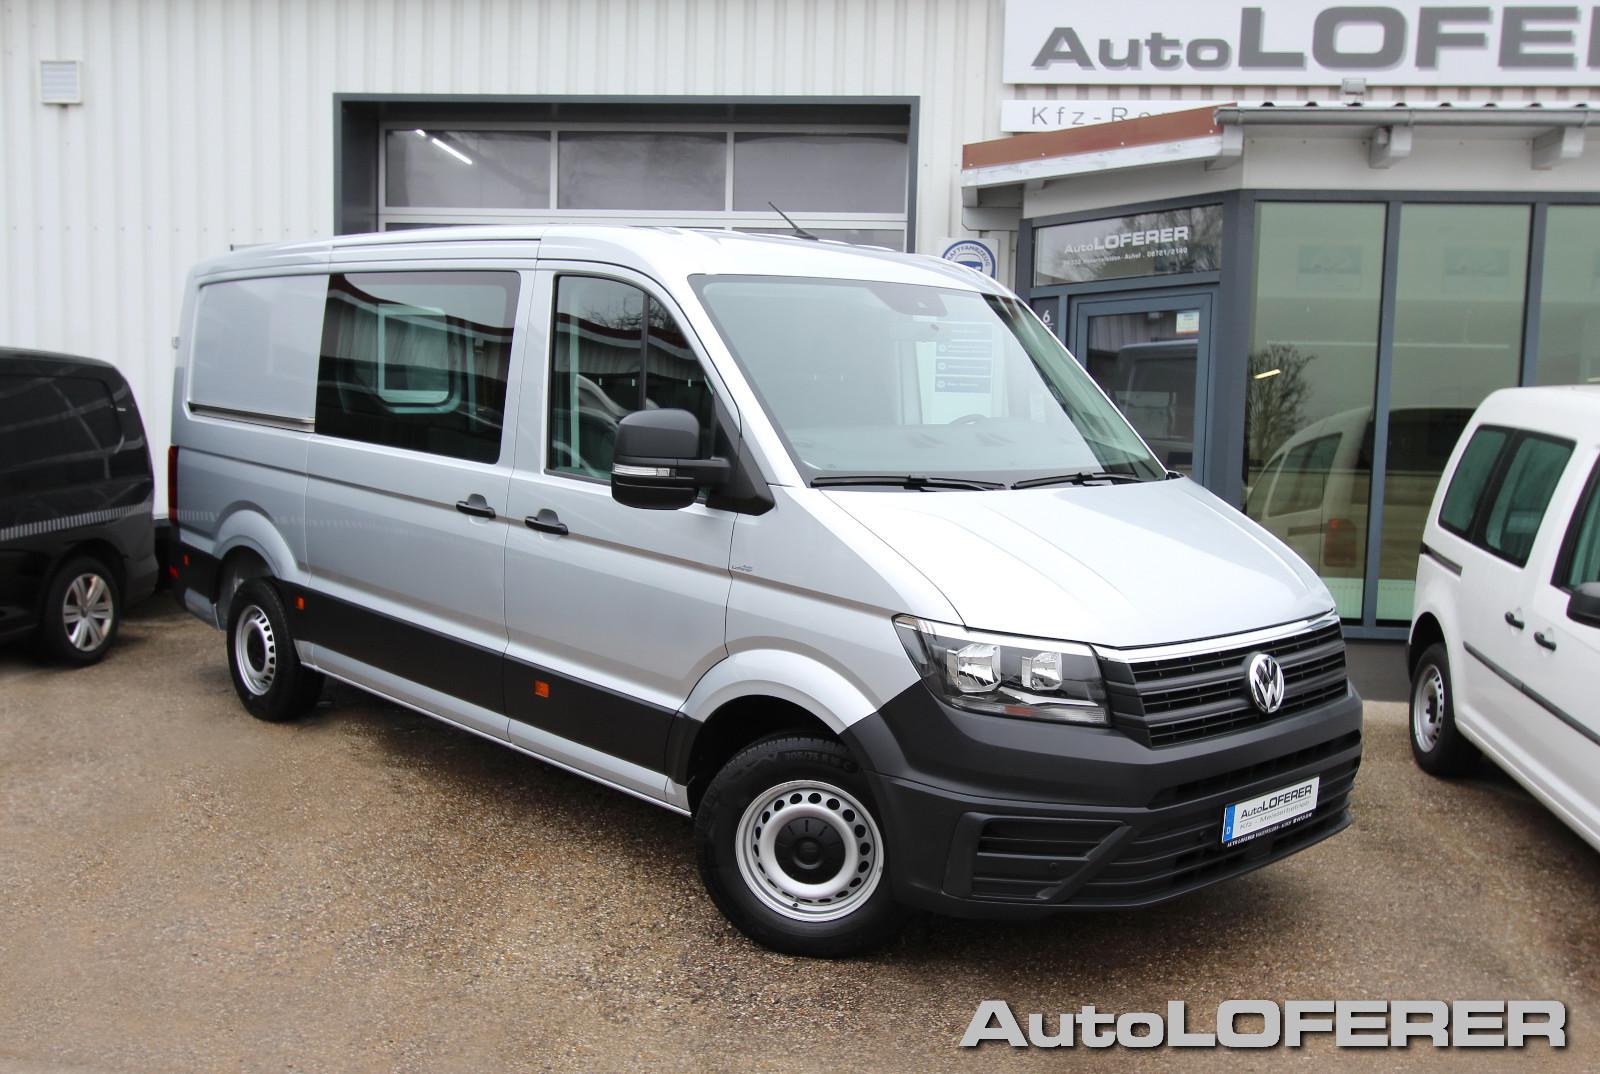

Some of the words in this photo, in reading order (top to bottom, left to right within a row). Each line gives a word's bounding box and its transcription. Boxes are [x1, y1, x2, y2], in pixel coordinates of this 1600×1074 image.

[1031, 6, 1600, 70] AutoLOFE
[1064, 225, 1189, 254] AutoLOFERER
[1042, 309, 1051, 324] 6
[1240, 784, 1313, 819] AutoLOFERER
